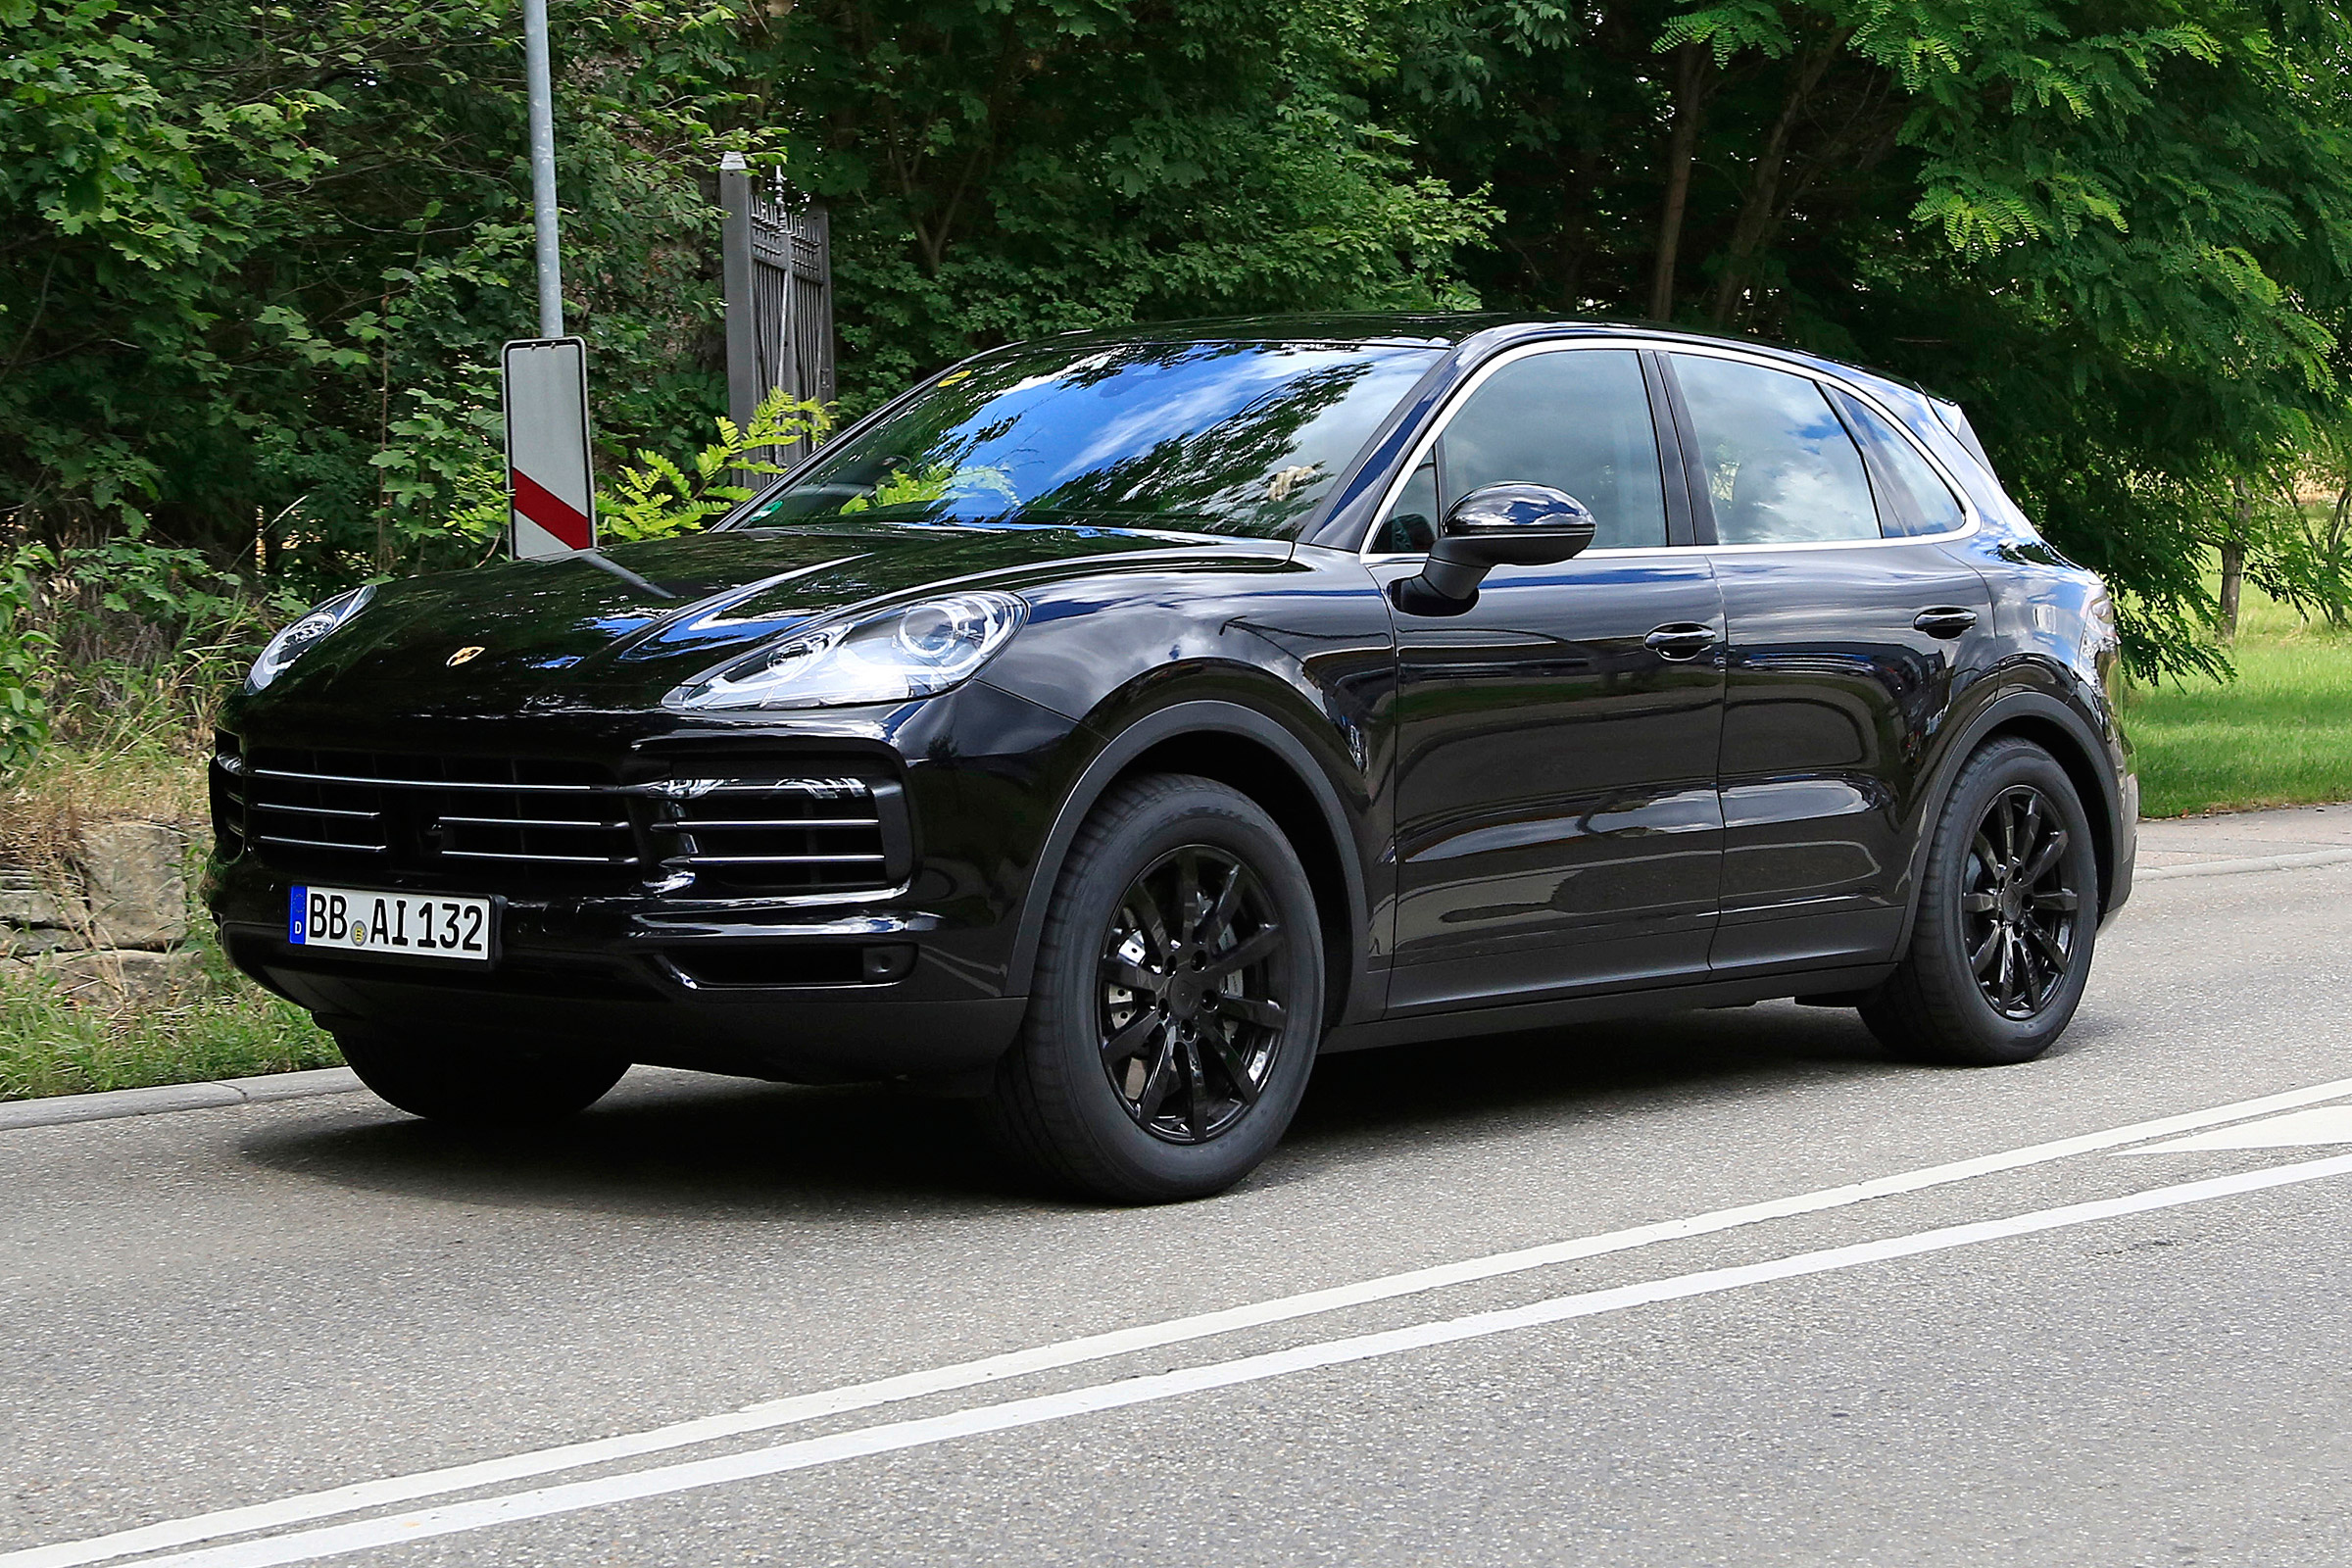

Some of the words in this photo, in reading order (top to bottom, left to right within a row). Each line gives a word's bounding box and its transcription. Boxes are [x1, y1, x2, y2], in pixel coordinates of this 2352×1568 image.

[294, 920, 304, 935] D
[309, 893, 348, 940] BB
[369, 898, 409, 946] AI
[416, 903, 482, 951] 132
